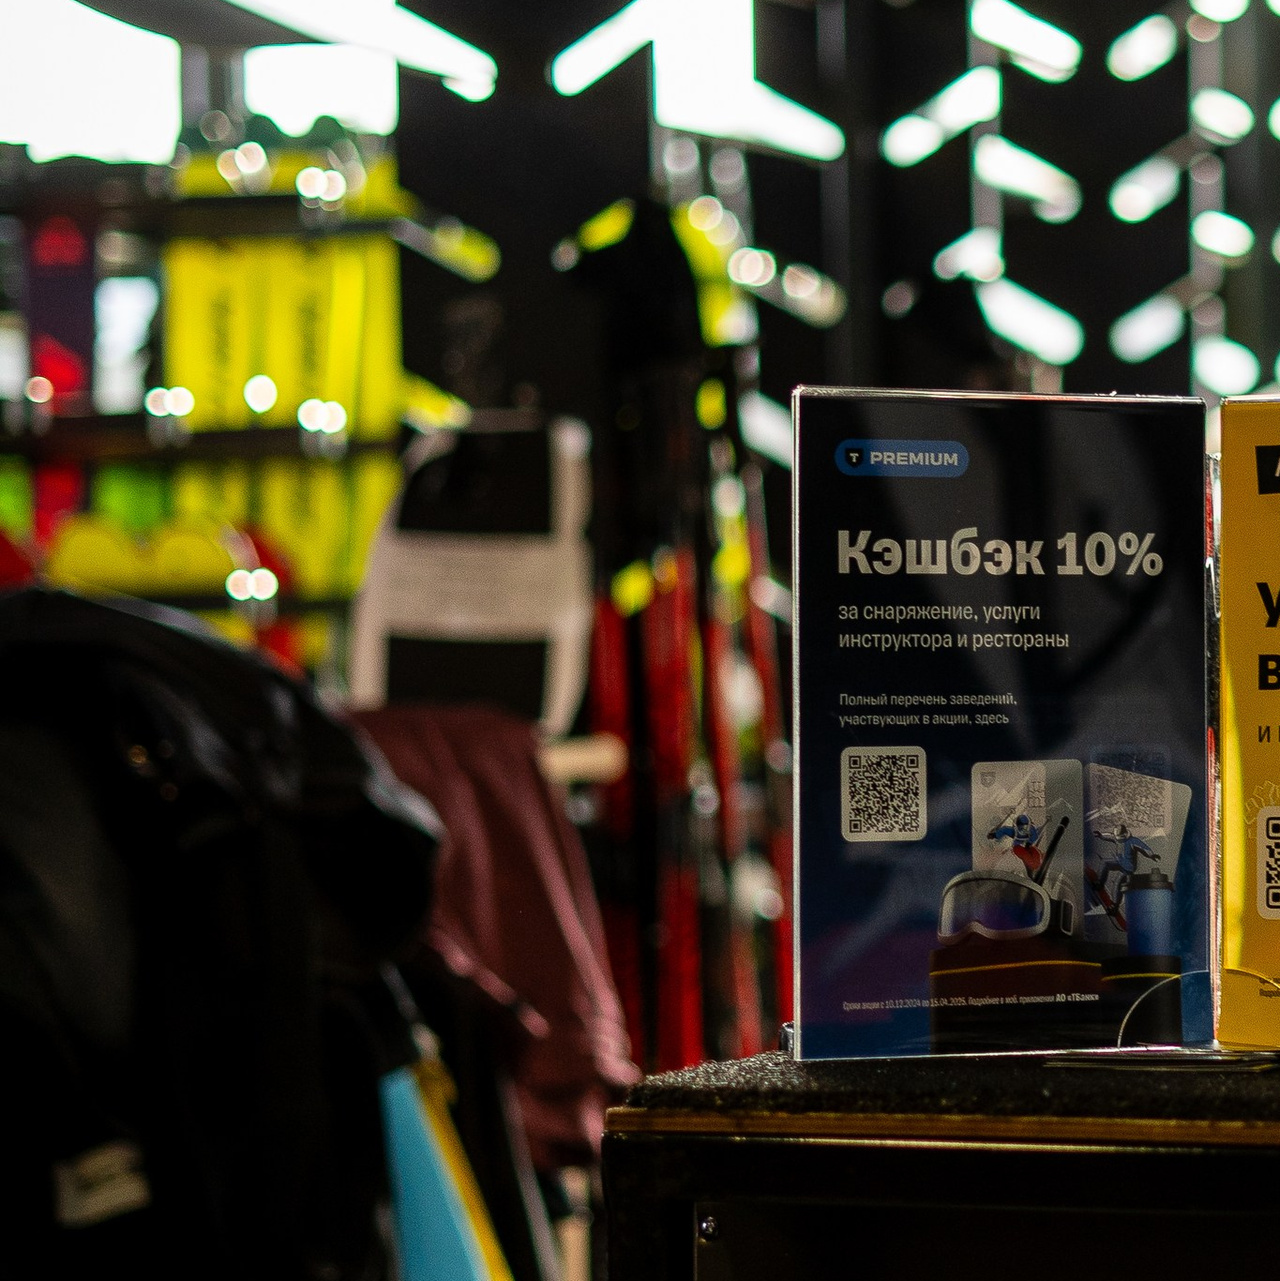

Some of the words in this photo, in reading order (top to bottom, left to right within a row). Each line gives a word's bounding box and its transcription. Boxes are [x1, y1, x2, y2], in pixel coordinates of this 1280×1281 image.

[869, 451, 959, 466] PREMIUM
[837, 527, 1046, 576] Кэшбэк
[1056, 531, 1164, 577] 10%
[838, 605, 859, 620] за
[863, 604, 978, 623] снаряжение,
[982, 603, 1041, 623] услуги
[838, 632, 952, 652] инструктора
[957, 633, 968, 647] и
[973, 632, 1070, 652] рестораны
[839, 693, 888, 706] Полный
[890, 694, 948, 708] перечень
[949, 692, 1017, 707] заведений,
[838, 713, 920, 728] участвующих
[922, 714, 930, 725] в
[932, 714, 972, 726] акции,
[974, 713, 1010, 725] здесь
[1257, 725, 1271, 743] и
